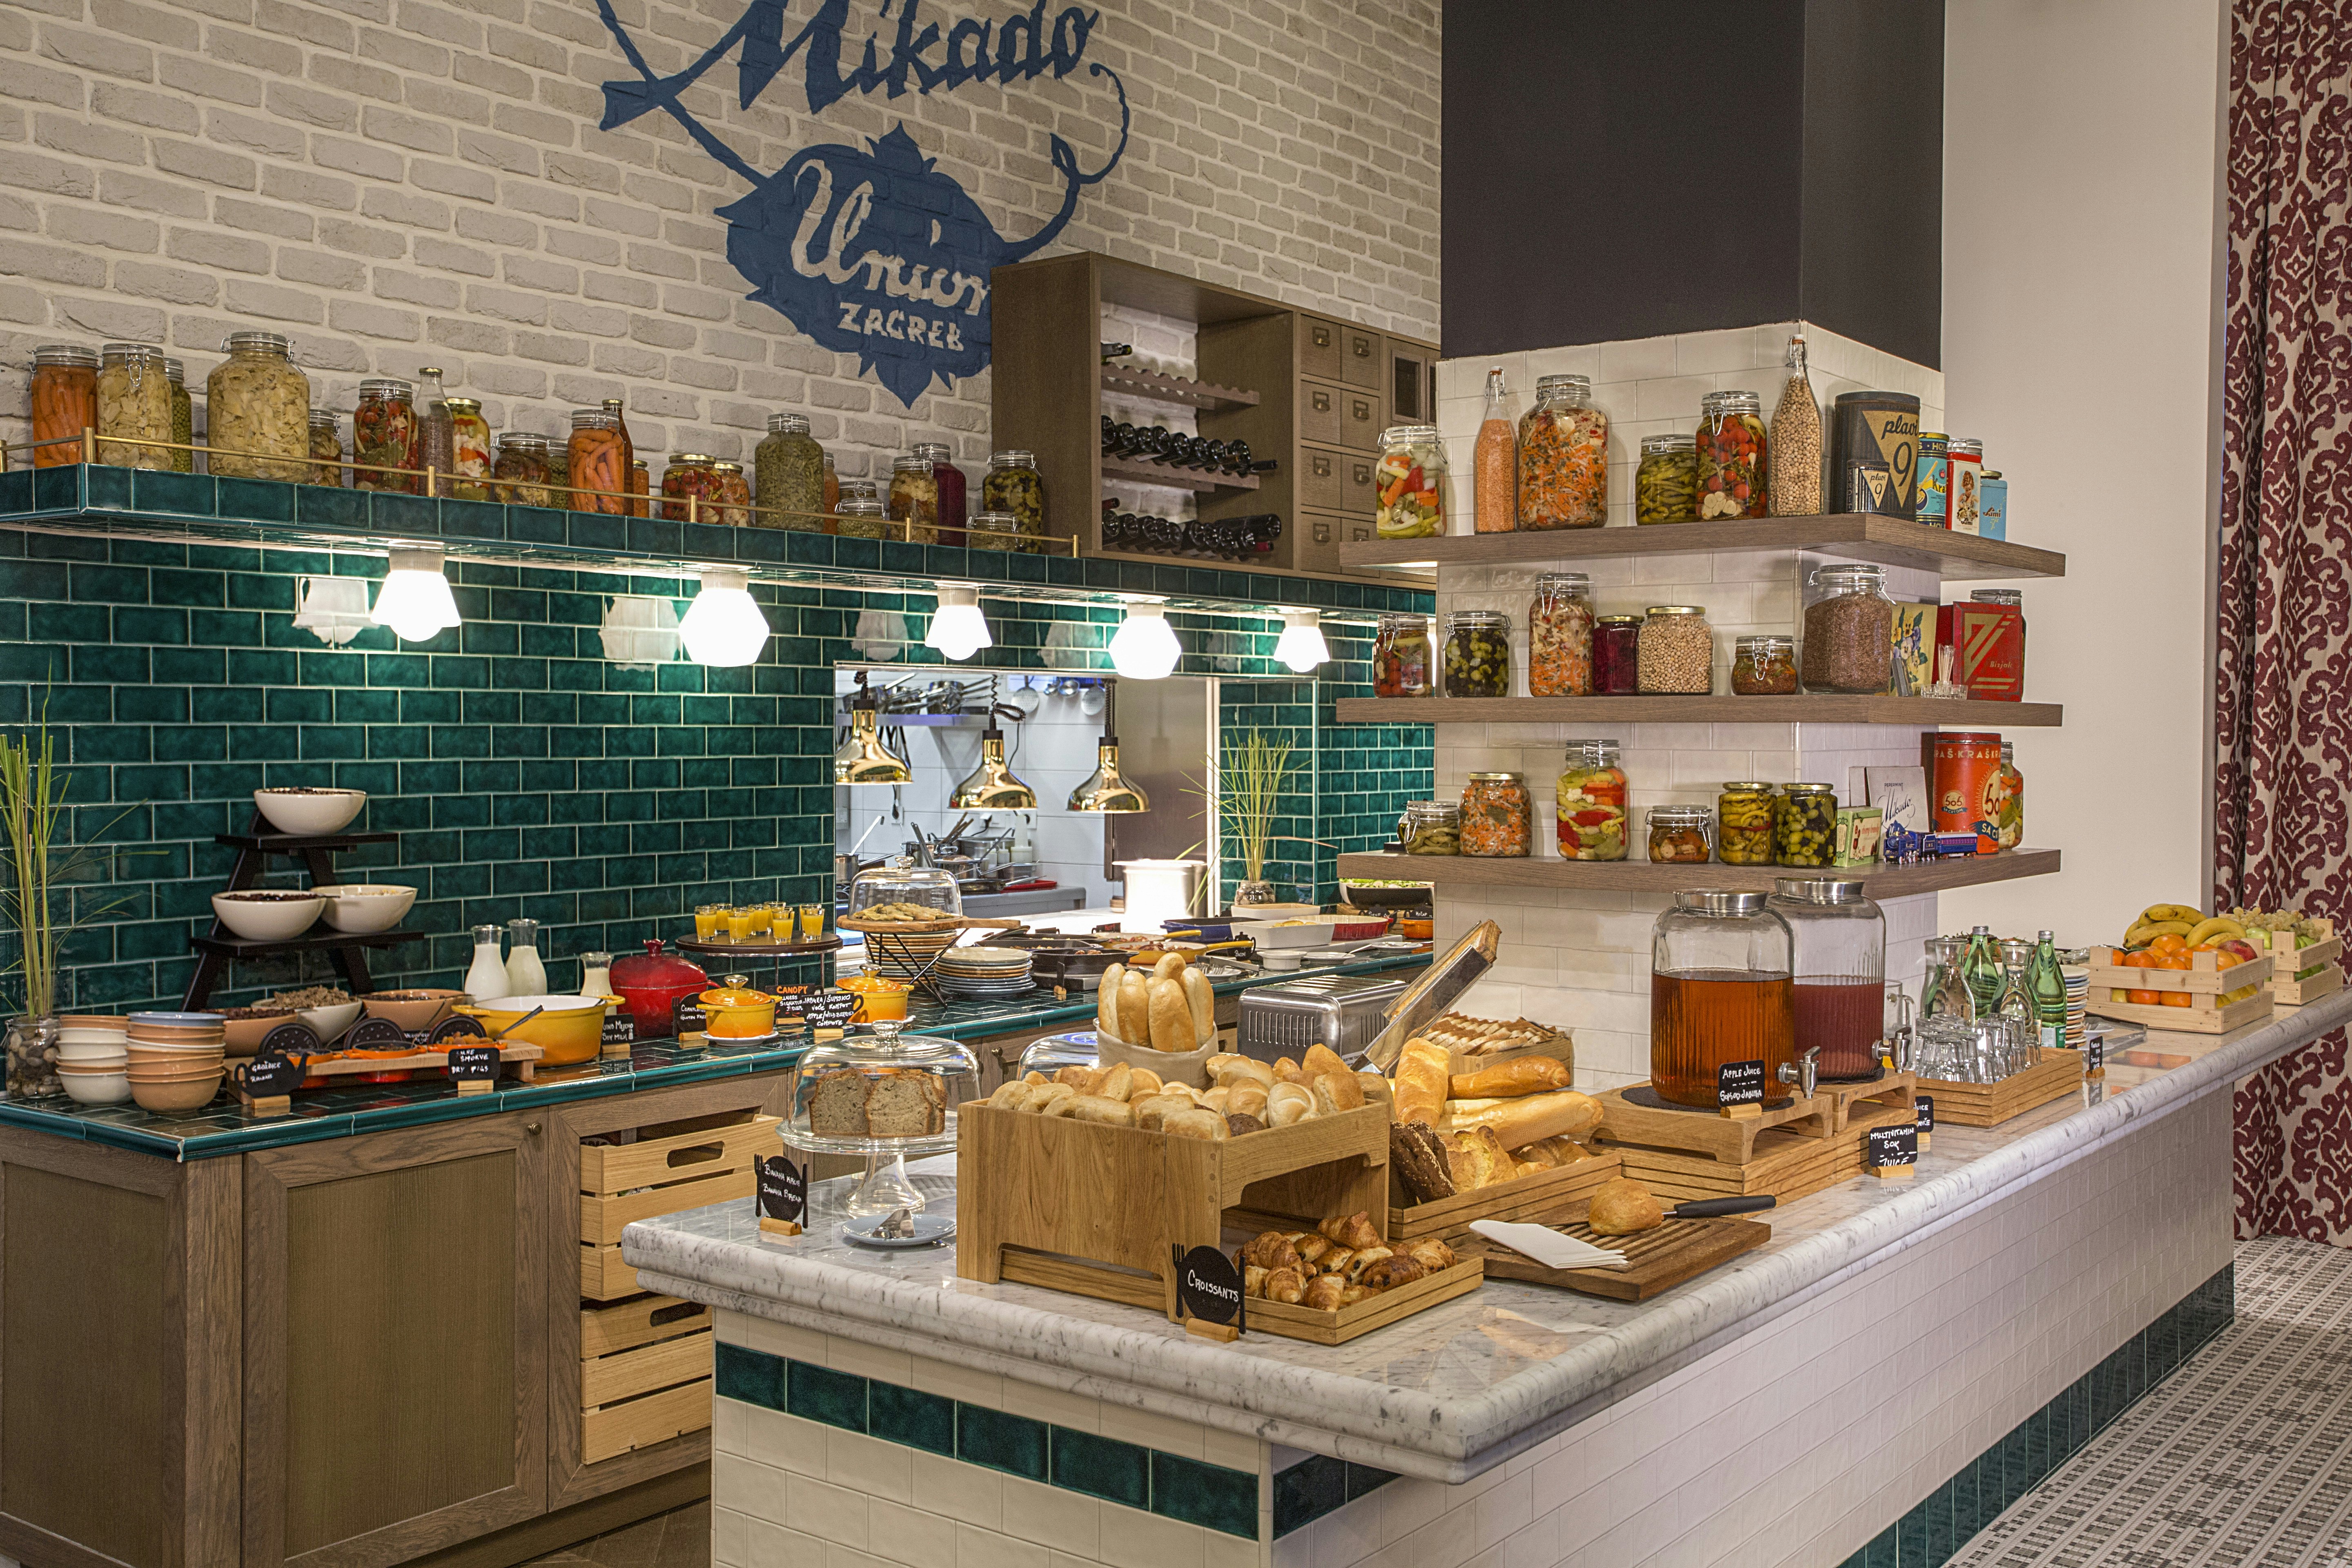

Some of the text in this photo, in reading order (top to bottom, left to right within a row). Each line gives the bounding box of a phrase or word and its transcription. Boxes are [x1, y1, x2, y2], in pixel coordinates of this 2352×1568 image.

[737, 0, 1099, 114] Mikado
[837, 302, 964, 352] ZAGREB
[1880, 414, 1918, 441] plavi
[1893, 441, 1912, 487] 9
[1870, 473, 1886, 483] plavi
[1875, 483, 1882, 499] 9
[1958, 748, 1989, 759] KRAŠ
[1884, 782, 1904, 791] PEPERMINT
[1878, 788, 1913, 823] Mikado
[1945, 795, 1962, 806] 505
[1982, 823, 1991, 835] SA
[776, 985, 808, 994] CANOPY
[602, 1033, 613, 1041] SOY
[451, 1066, 465, 1074] DRY
[1722, 1065, 1761, 1079] APPLE JUICE
[1870, 1127, 1914, 1140] MULTIVITAMIN
[1884, 1140, 1900, 1151] SOK
[764, 1164, 800, 1187] BANANA KRUH
[763, 1183, 802, 1203] BANANA BREAD
[1188, 1269, 1239, 1302] CROISSANTS
